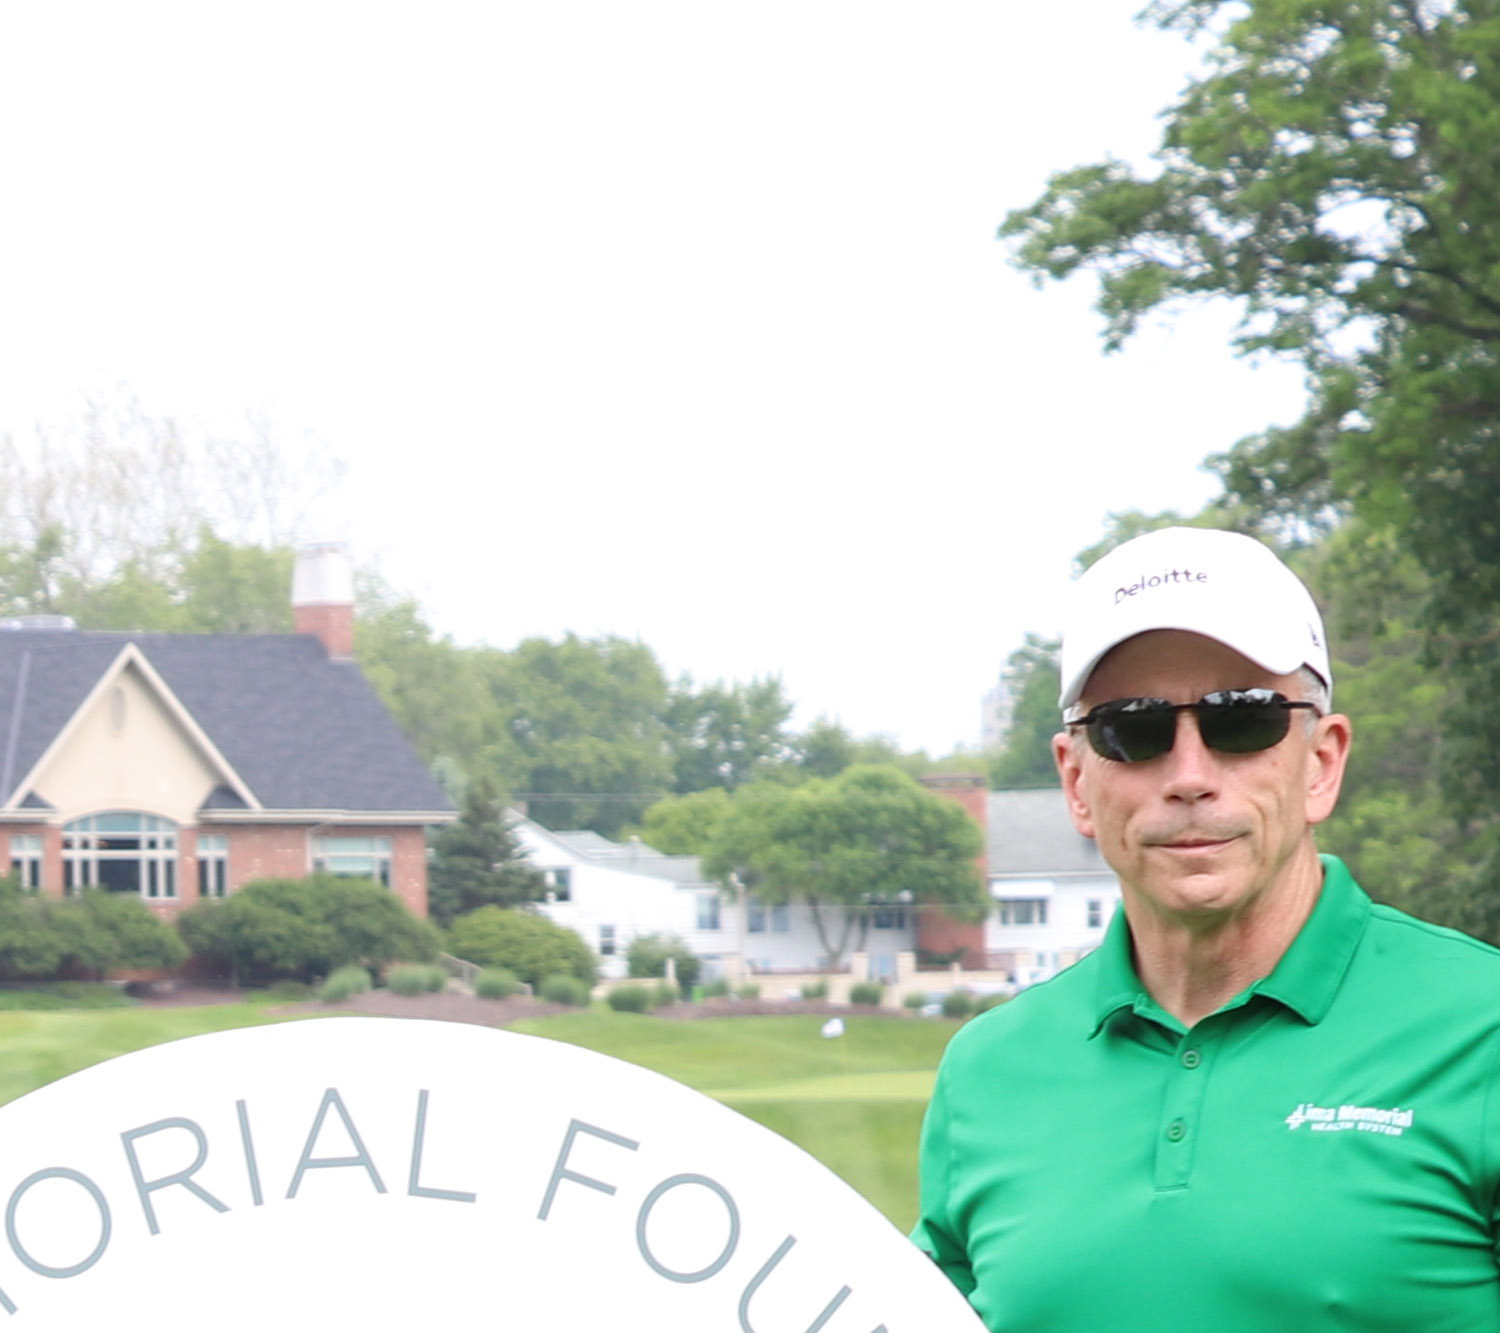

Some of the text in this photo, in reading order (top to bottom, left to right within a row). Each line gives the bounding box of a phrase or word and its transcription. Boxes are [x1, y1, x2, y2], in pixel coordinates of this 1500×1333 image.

[1114, 568, 1208, 605] Deloitte
[1296, 1103, 1414, 1128] Lima Memorial
